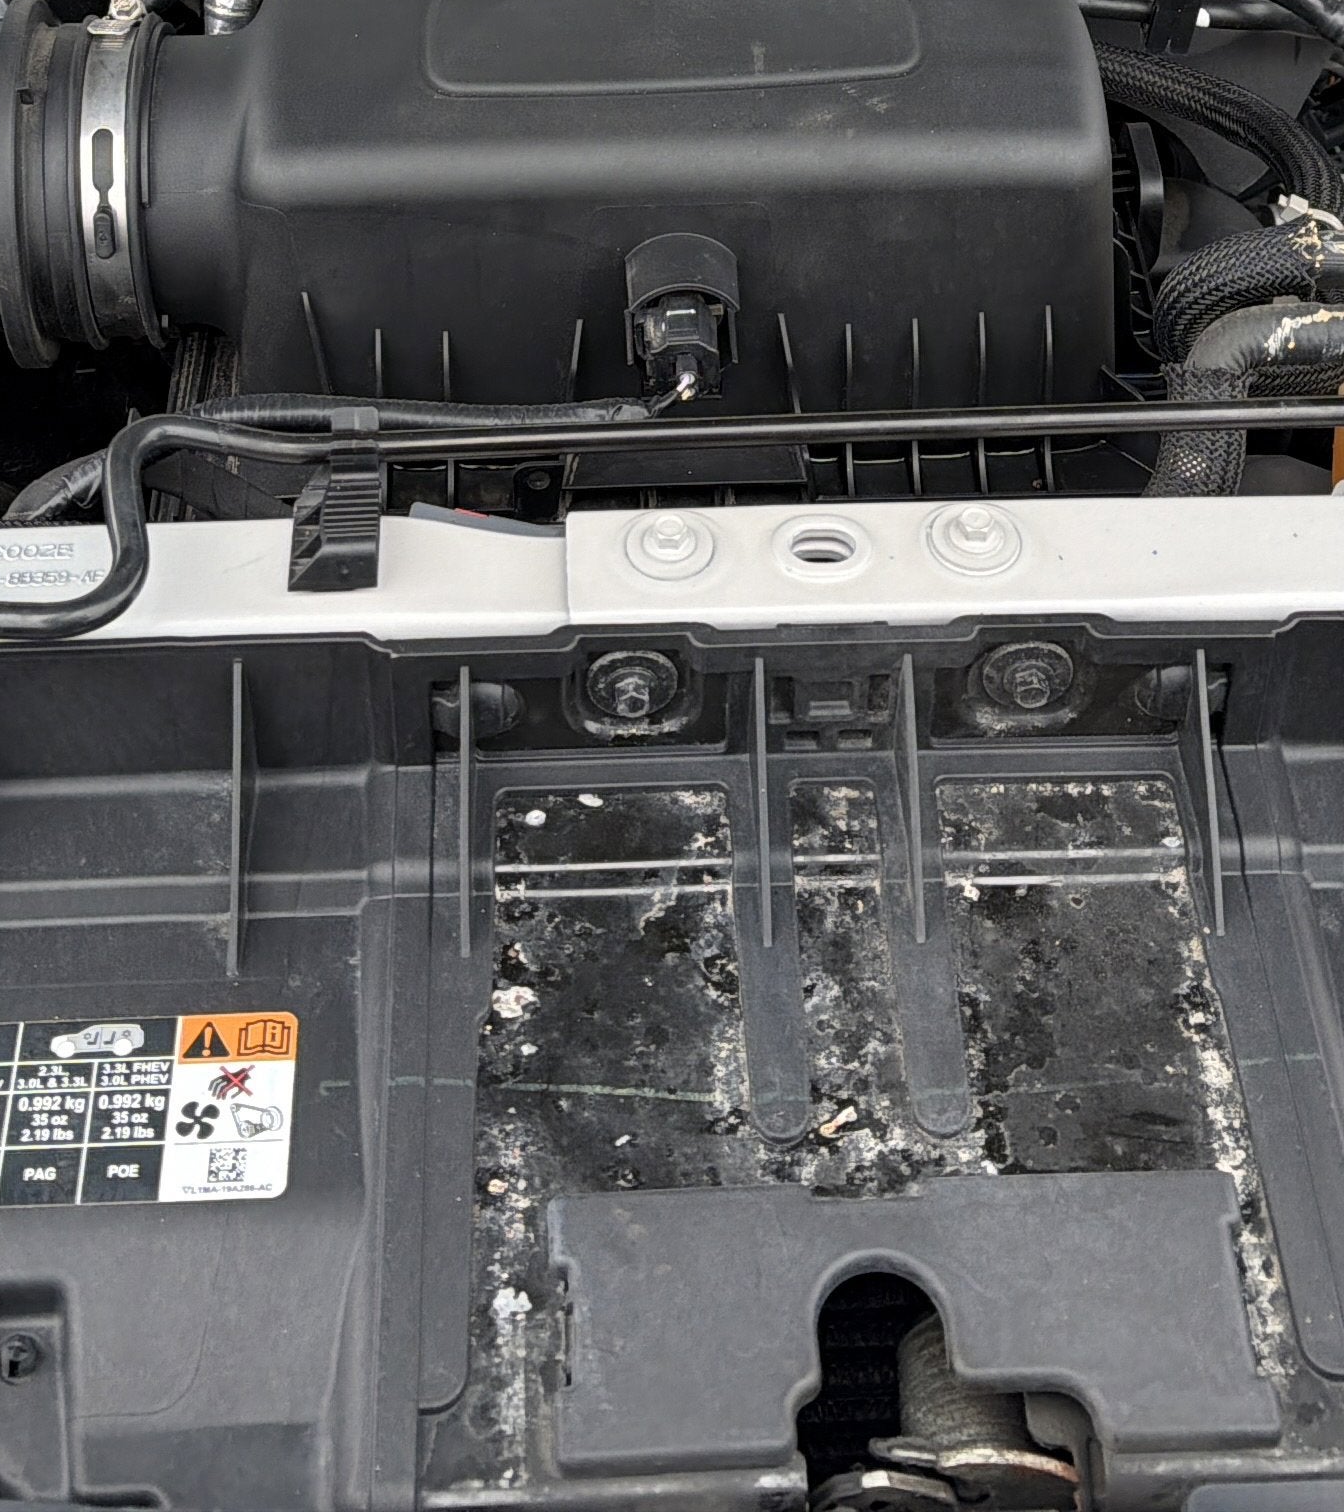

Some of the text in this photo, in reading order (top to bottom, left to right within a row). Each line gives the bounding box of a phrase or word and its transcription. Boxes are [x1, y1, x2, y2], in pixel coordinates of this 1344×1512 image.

[102, 1061, 170, 1075] 3.3L FHEV
[16, 1075, 89, 1089] 3.0L & 3.3L
[99, 1073, 169, 1086] 3.0L PHEV
[17, 1095, 86, 1114] 0.992 kg
[97, 1092, 166, 1111] 0.992 kg
[30, 1113, 69, 1127] 35 oz
[110, 1111, 149, 1124] 35 oz
[20, 1127, 75, 1143] 2.19 lbs
[100, 1125, 155, 1140] 2.19 lbs
[22, 1166, 57, 1181] PAG
[106, 1163, 141, 1179] POE
